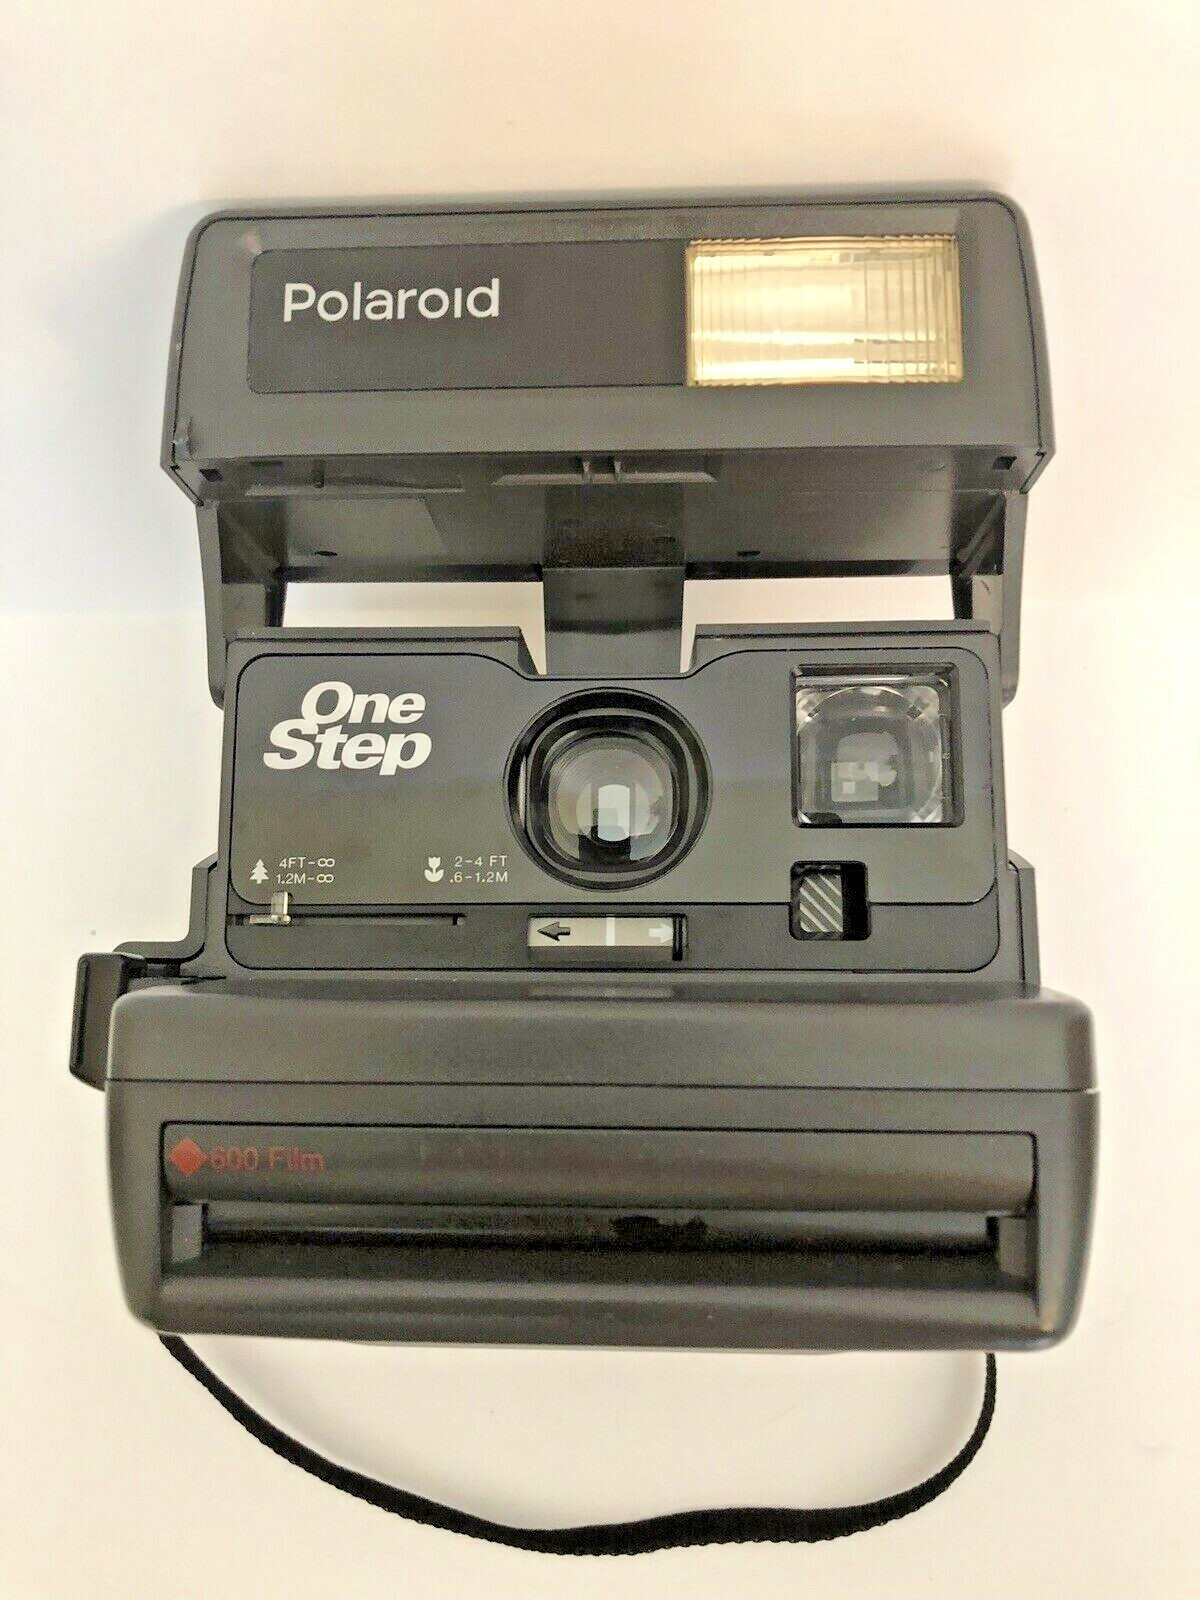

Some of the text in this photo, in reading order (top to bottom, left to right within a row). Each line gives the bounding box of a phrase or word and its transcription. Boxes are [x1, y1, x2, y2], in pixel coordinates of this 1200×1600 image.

[283, 277, 500, 322] Polaroid
[300, 680, 426, 724] One
[262, 718, 432, 776] Step
[453, 855, 508, 868] 2-4 FT
[209, 1146, 326, 1171] 600 Film
